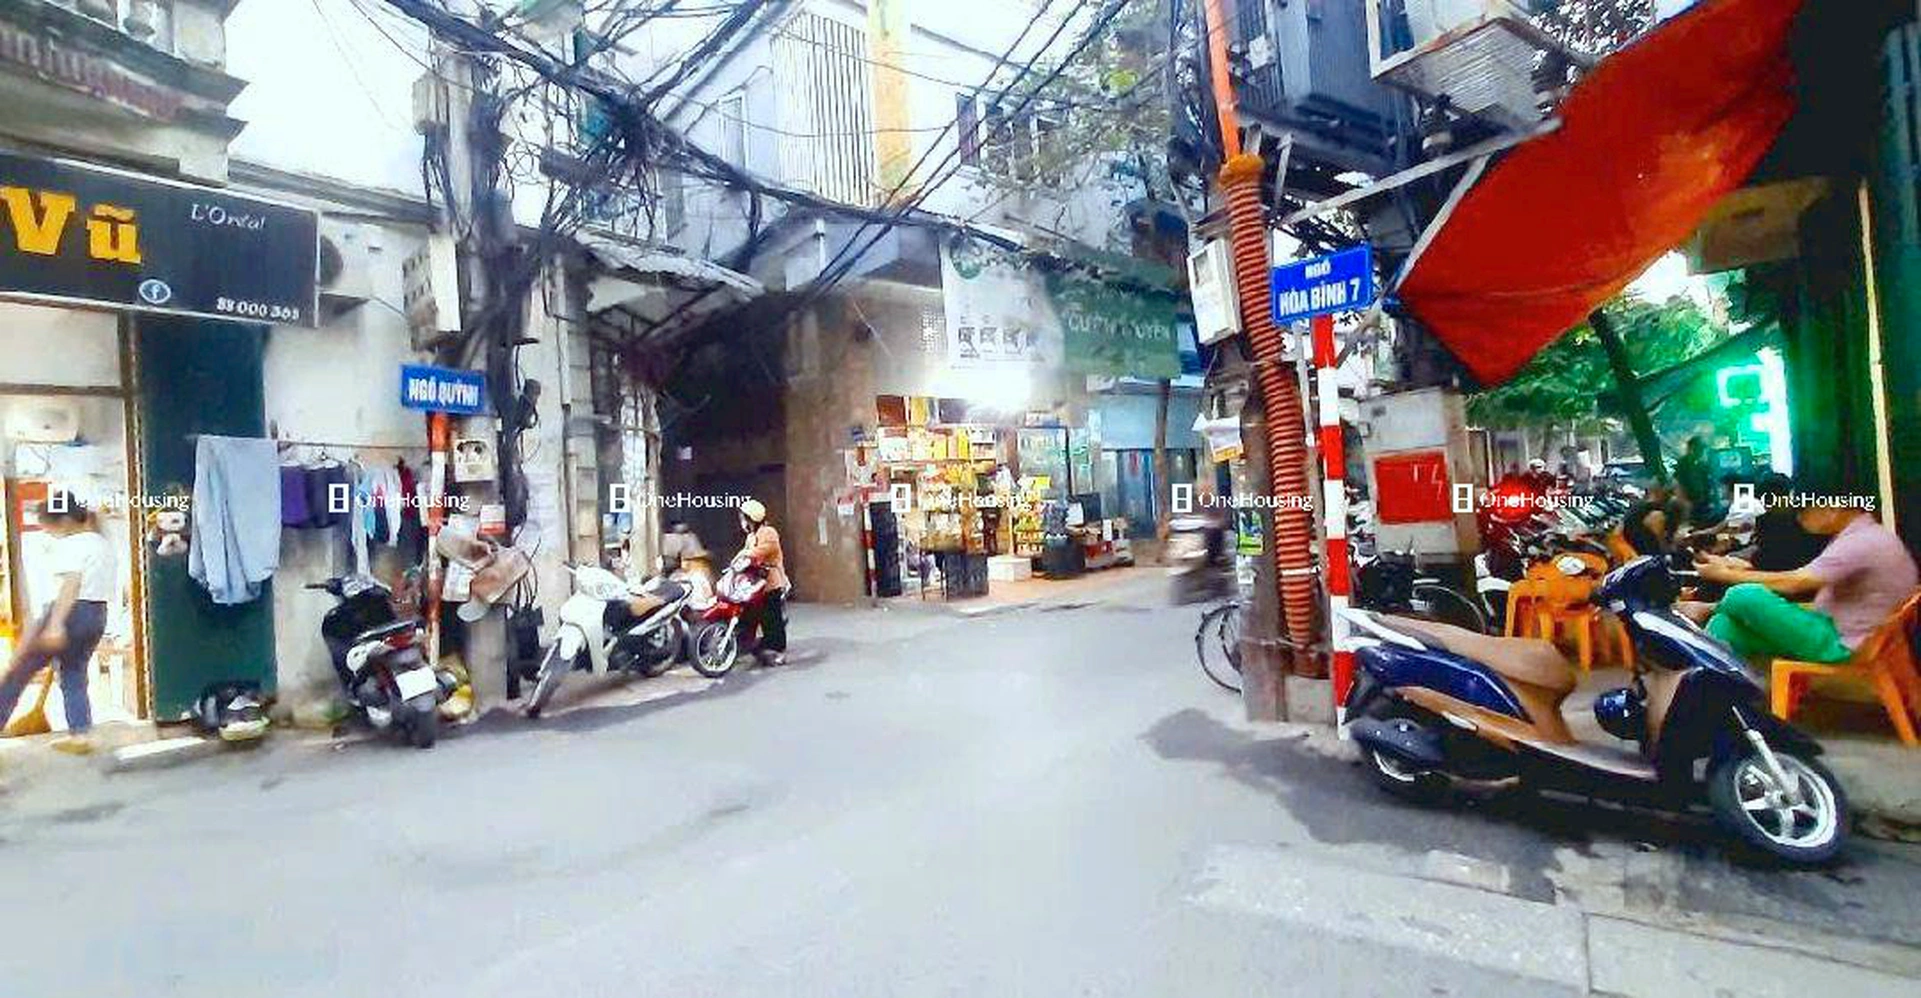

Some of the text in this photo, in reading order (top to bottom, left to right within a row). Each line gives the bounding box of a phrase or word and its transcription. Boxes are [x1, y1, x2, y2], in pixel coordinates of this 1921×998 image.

[0, 185, 142, 264] Vũ
[1279, 277, 1360, 317] HÒA BÌNH 7
